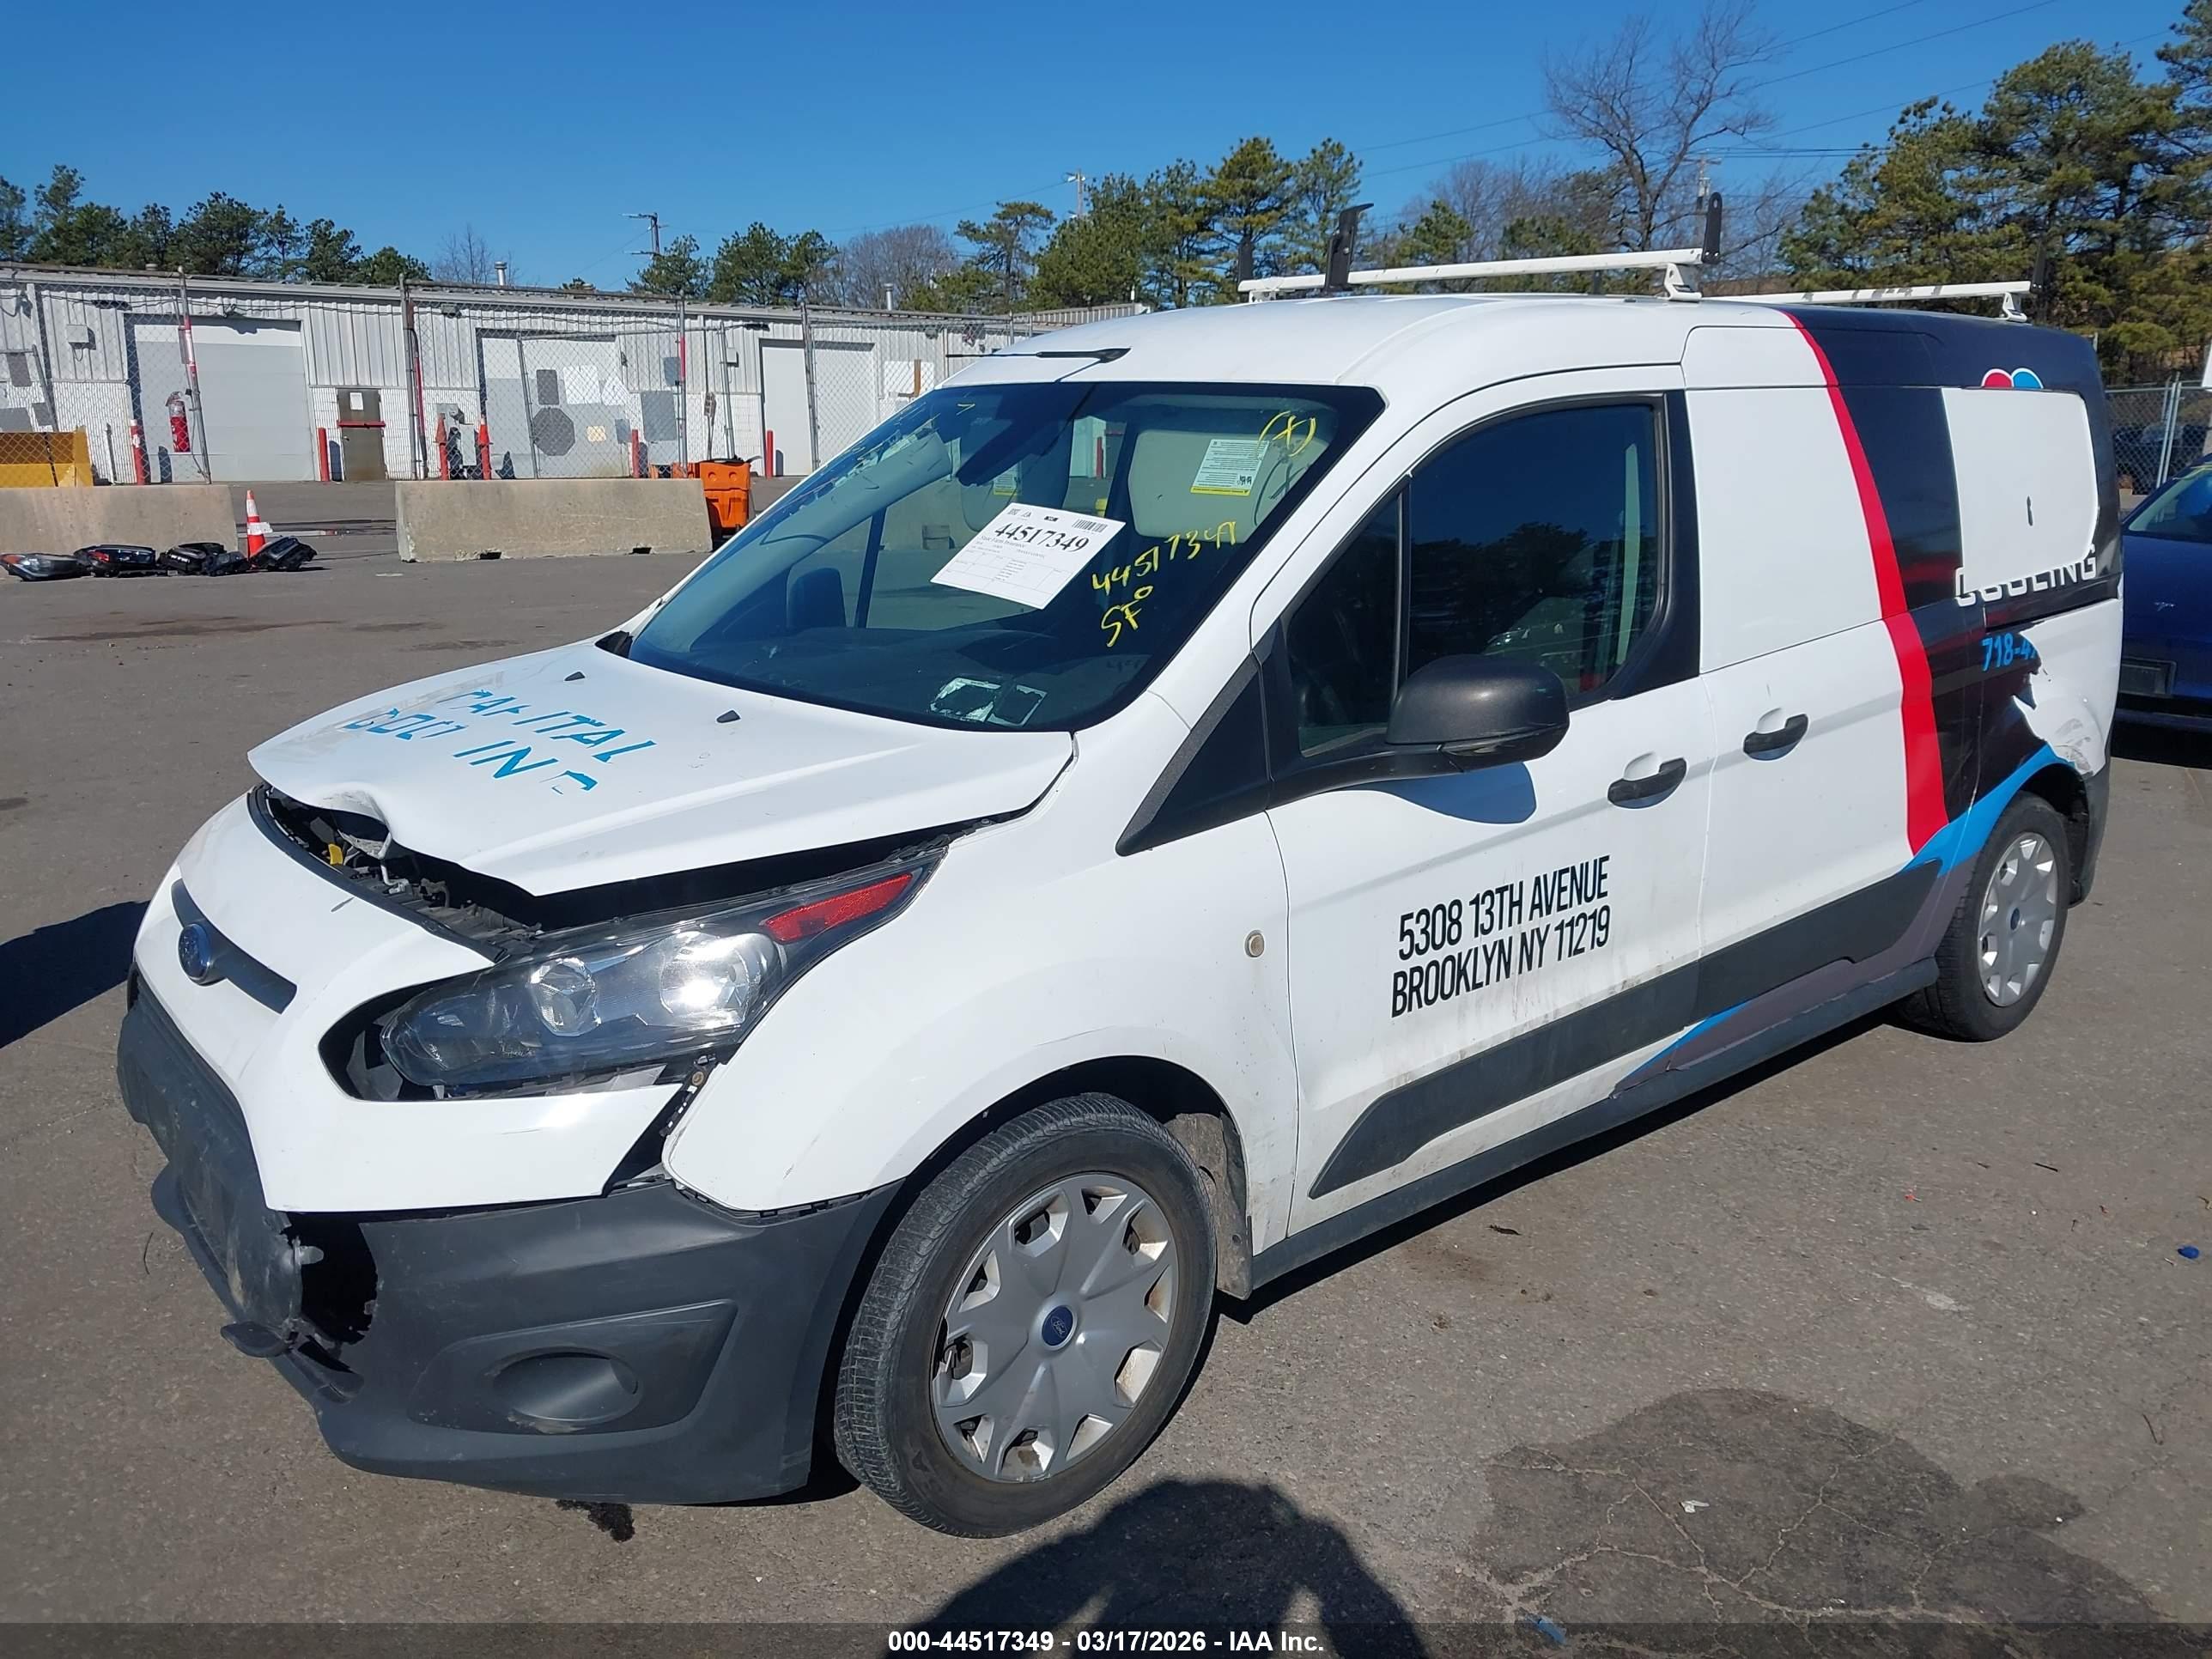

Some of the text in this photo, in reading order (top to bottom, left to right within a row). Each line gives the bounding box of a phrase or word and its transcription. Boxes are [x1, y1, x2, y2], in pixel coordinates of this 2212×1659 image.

[994, 522, 1089, 552] 44517349
[1391, 904, 1611, 1018] BROOKLYN NY 11219
[1399, 854, 1610, 961] 5308 13TH AVENUE
